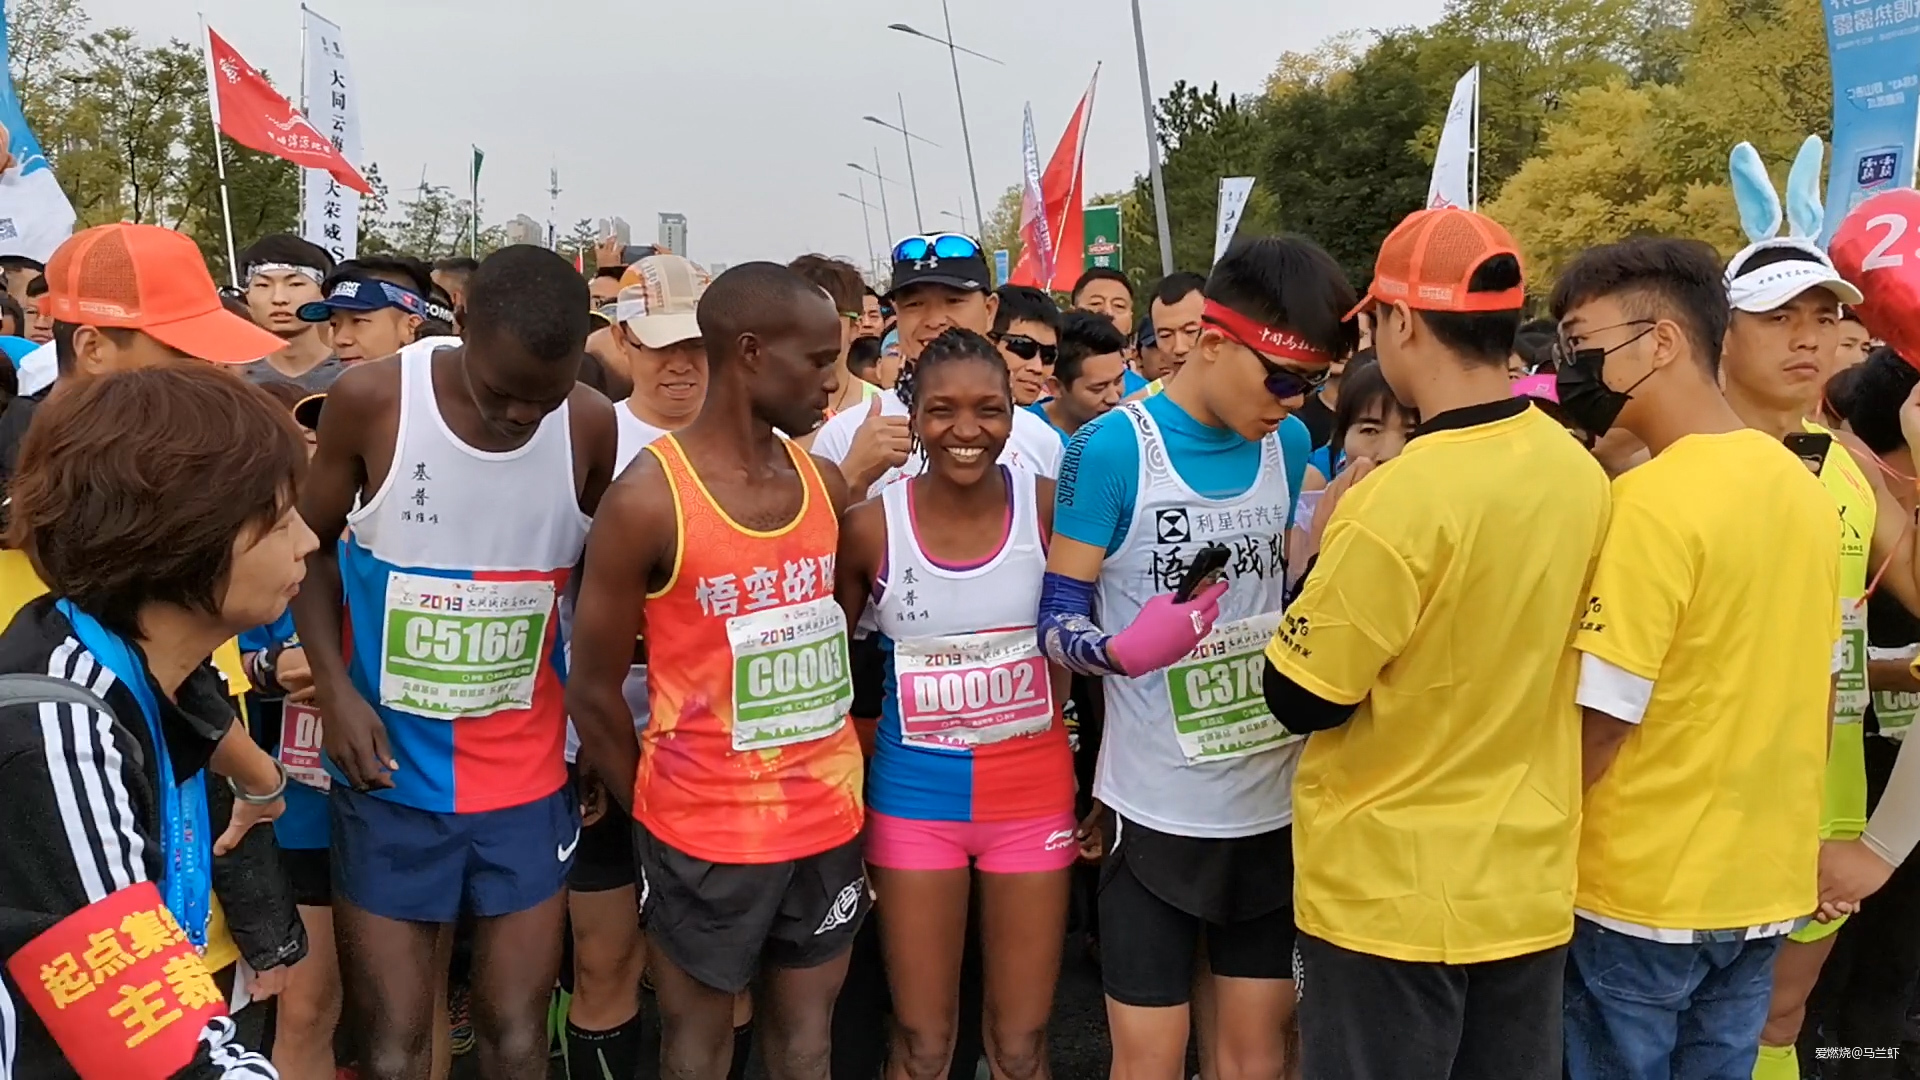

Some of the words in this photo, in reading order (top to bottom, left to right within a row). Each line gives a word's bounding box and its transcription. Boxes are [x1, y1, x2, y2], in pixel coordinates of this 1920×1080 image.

[1196, 504, 1284, 533] 利星行汽车
[1148, 533, 1289, 593] 悟战队
[420, 594, 463, 611] 2019
[405, 616, 530, 663] C5166
[761, 626, 795, 646] 2019
[748, 638, 842, 697] C0003
[924, 653, 962, 667] 2019
[914, 662, 1035, 713] D0002
[107, 952, 225, 1049] 主裁
